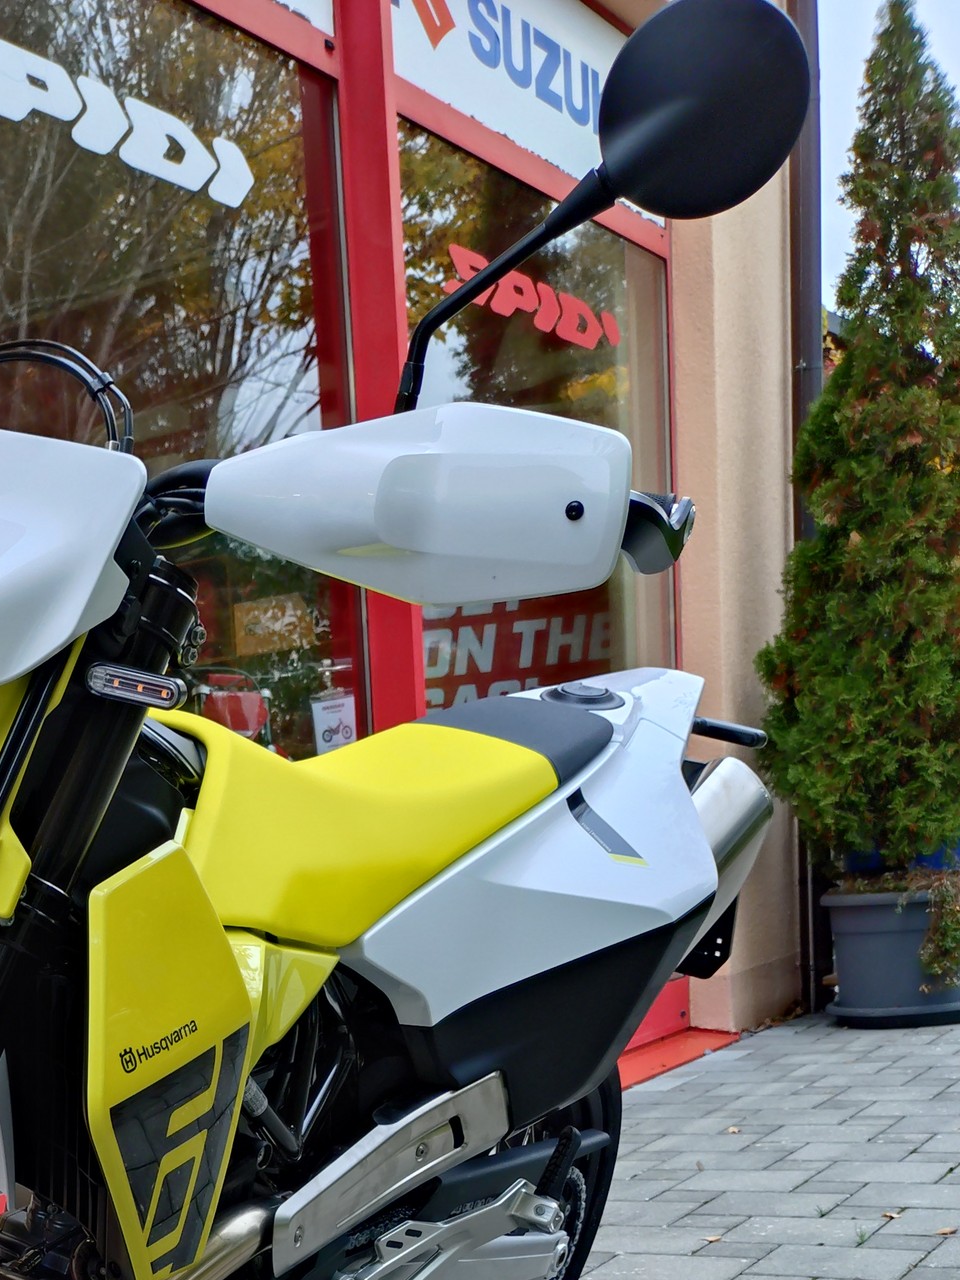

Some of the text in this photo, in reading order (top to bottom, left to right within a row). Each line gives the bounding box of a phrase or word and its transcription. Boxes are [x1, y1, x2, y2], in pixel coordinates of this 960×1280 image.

[422, 611, 611, 679] ON THE
[137, 1019, 198, 1064] Husqvarna
